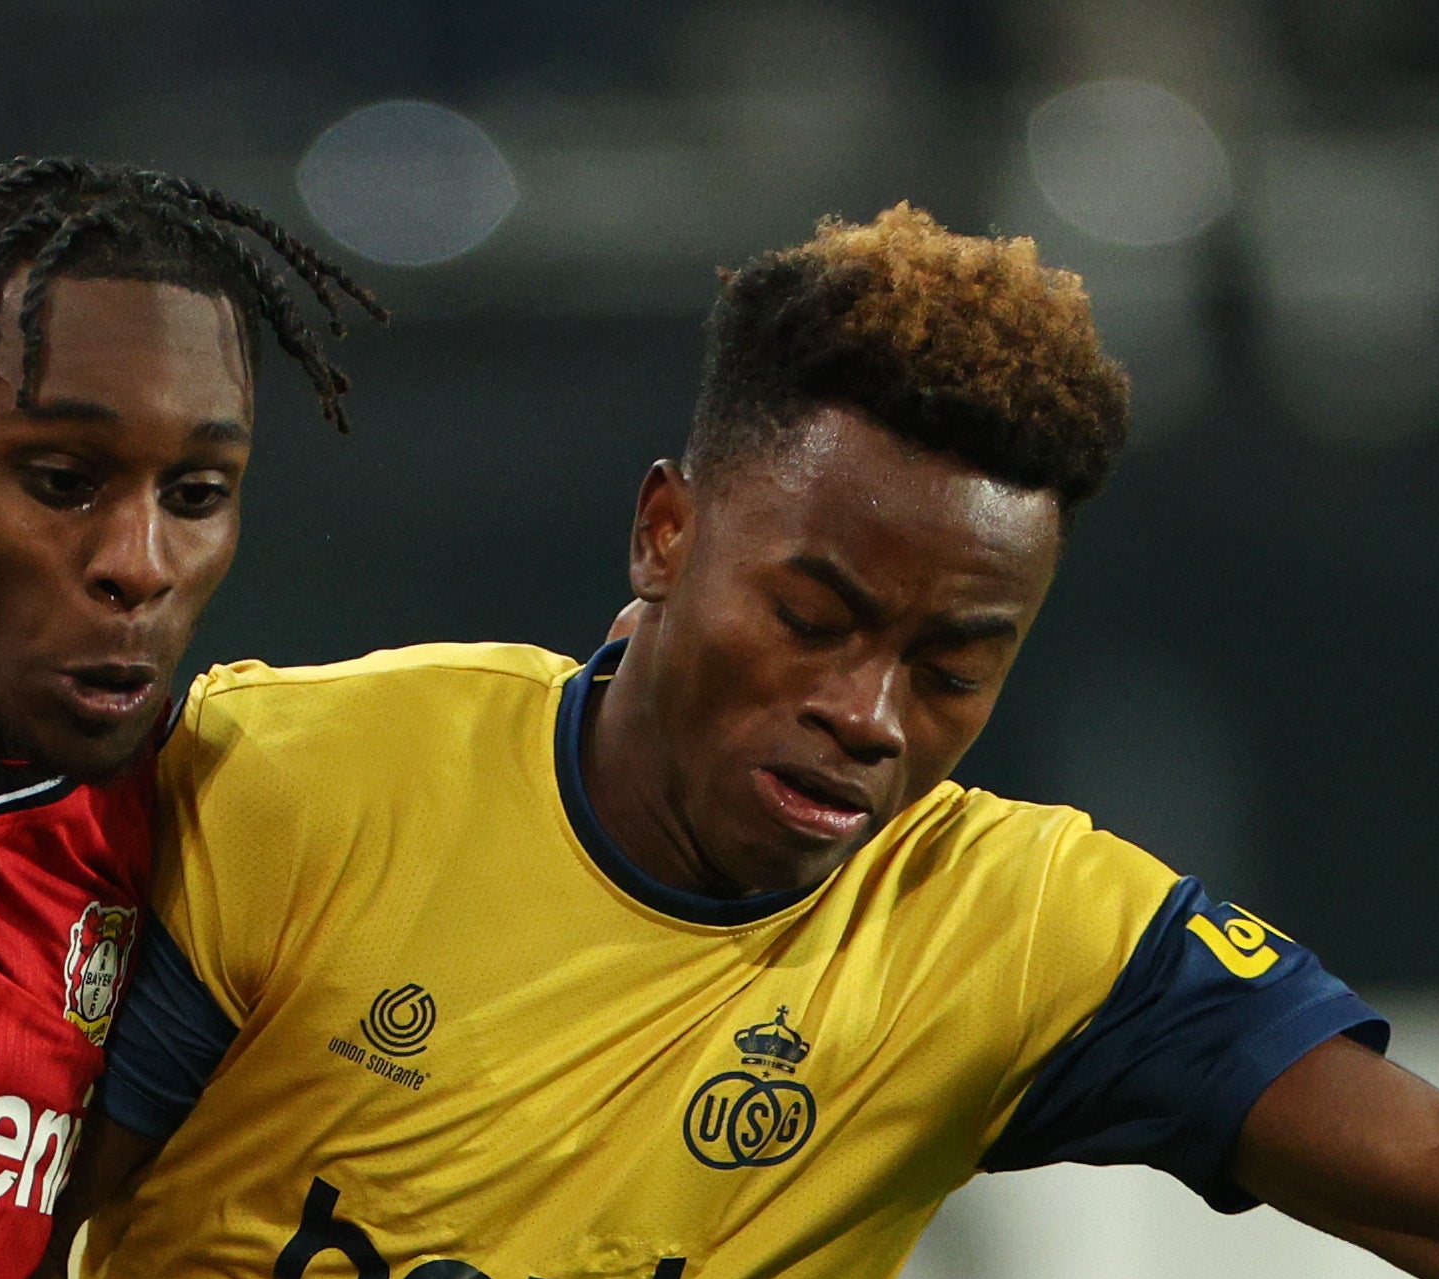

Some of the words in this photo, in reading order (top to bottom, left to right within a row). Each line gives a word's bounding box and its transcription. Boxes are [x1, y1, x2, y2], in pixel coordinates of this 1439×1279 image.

[85, 972, 112, 988] BAYER
[327, 1035, 367, 1065] union
[366, 1053, 425, 1092] soixante
